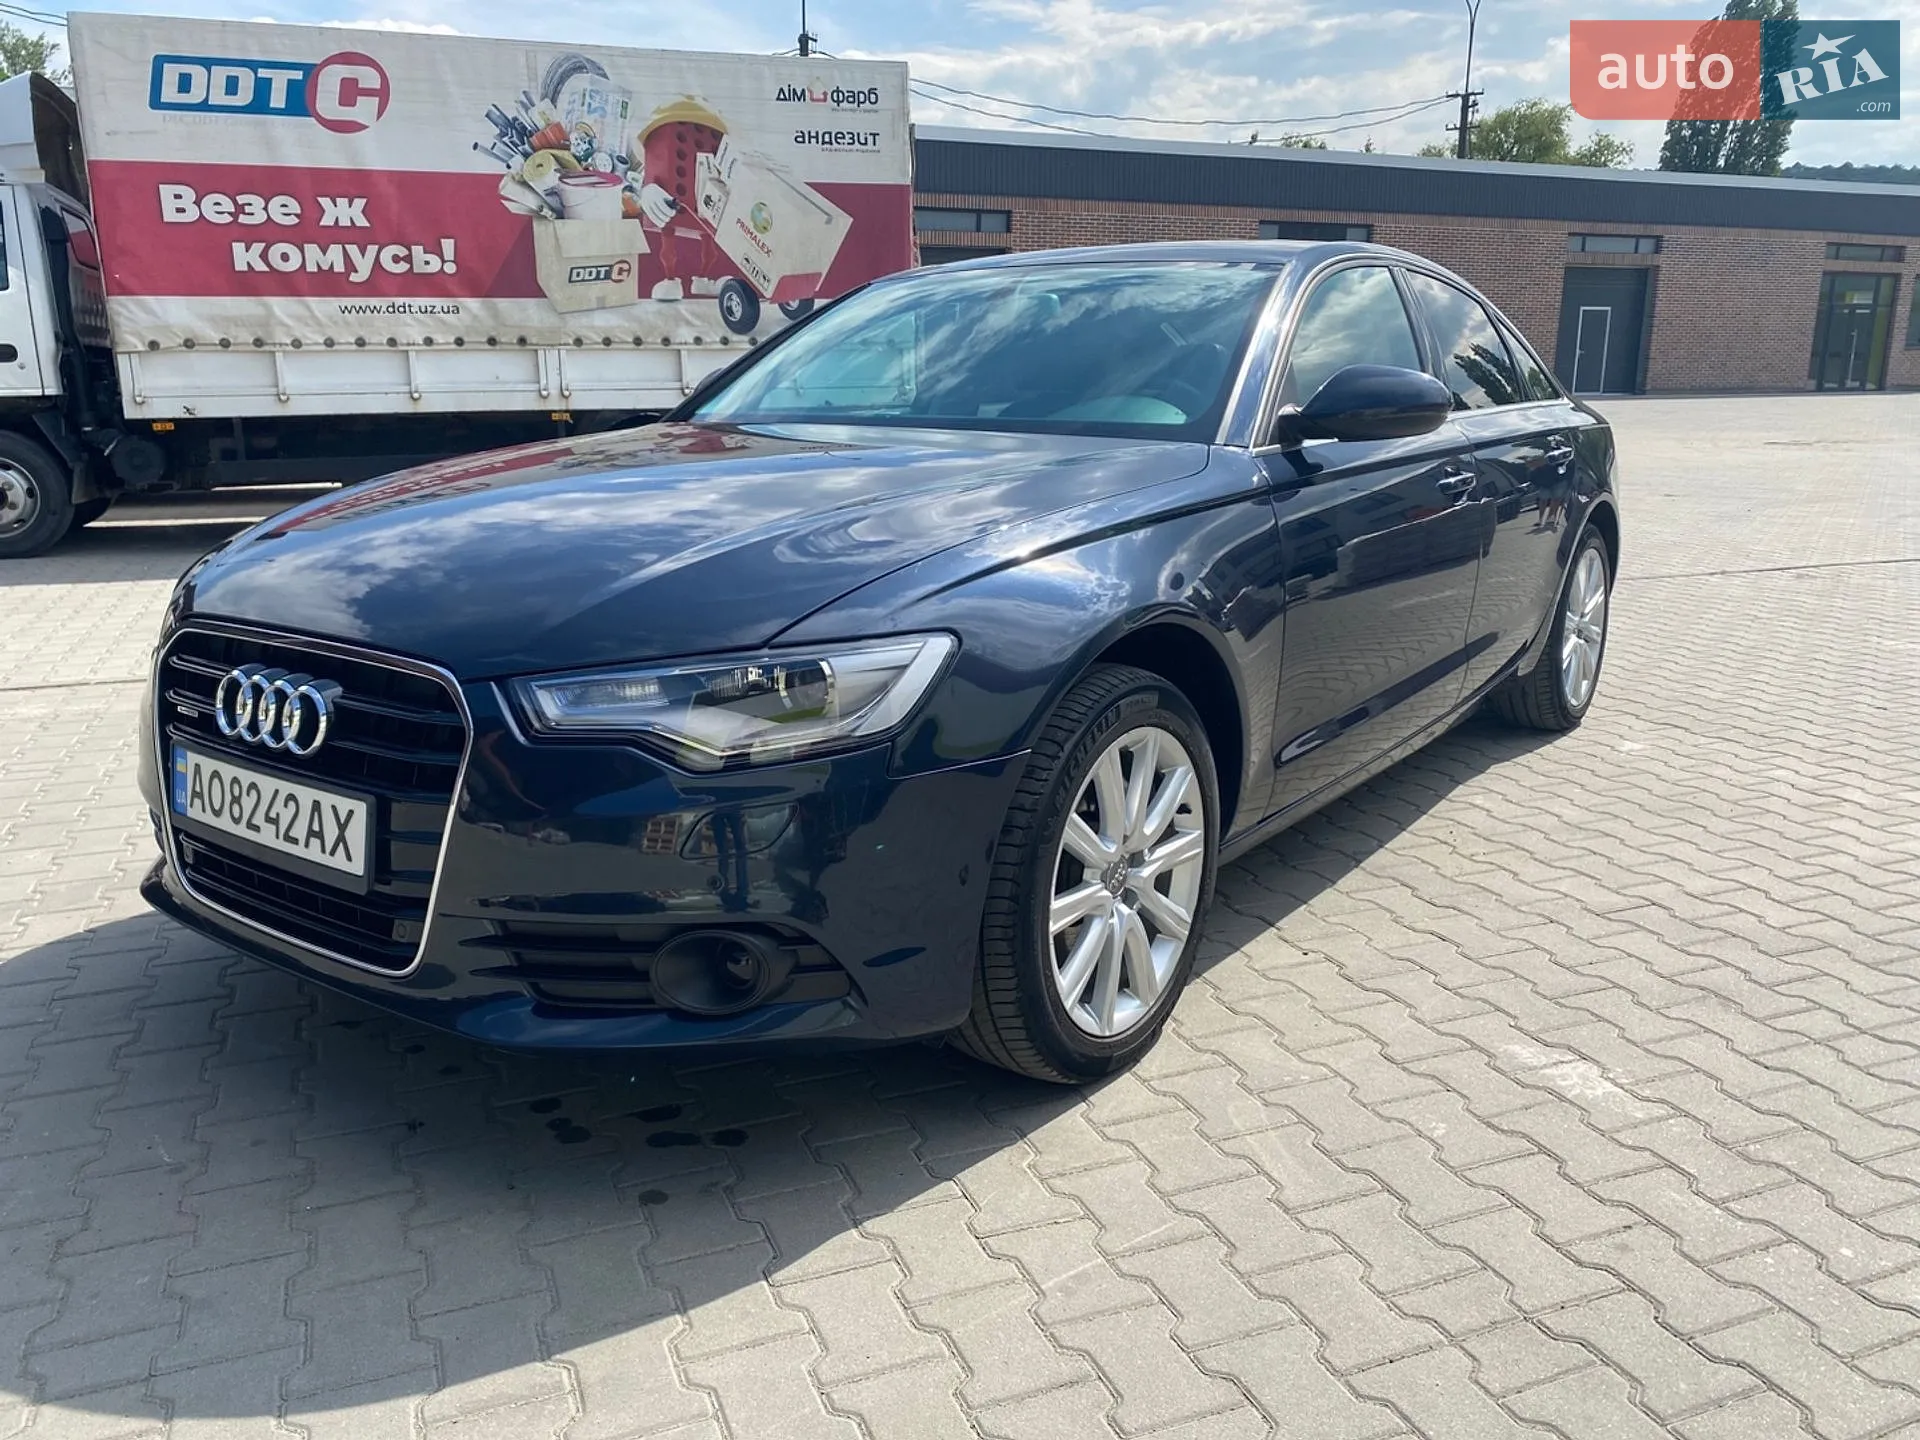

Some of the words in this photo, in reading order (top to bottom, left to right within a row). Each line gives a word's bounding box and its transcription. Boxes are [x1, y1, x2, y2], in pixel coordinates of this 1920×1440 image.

[158, 183, 302, 226] Везе
[316, 196, 370, 227] ж
[736, 218, 773, 257] PRIMALEX
[231, 238, 457, 283] комусь!
[339, 303, 460, 315] www.ddt.uz.ua
[176, 788, 187, 804] UA
[189, 762, 355, 863] AO8242AX
